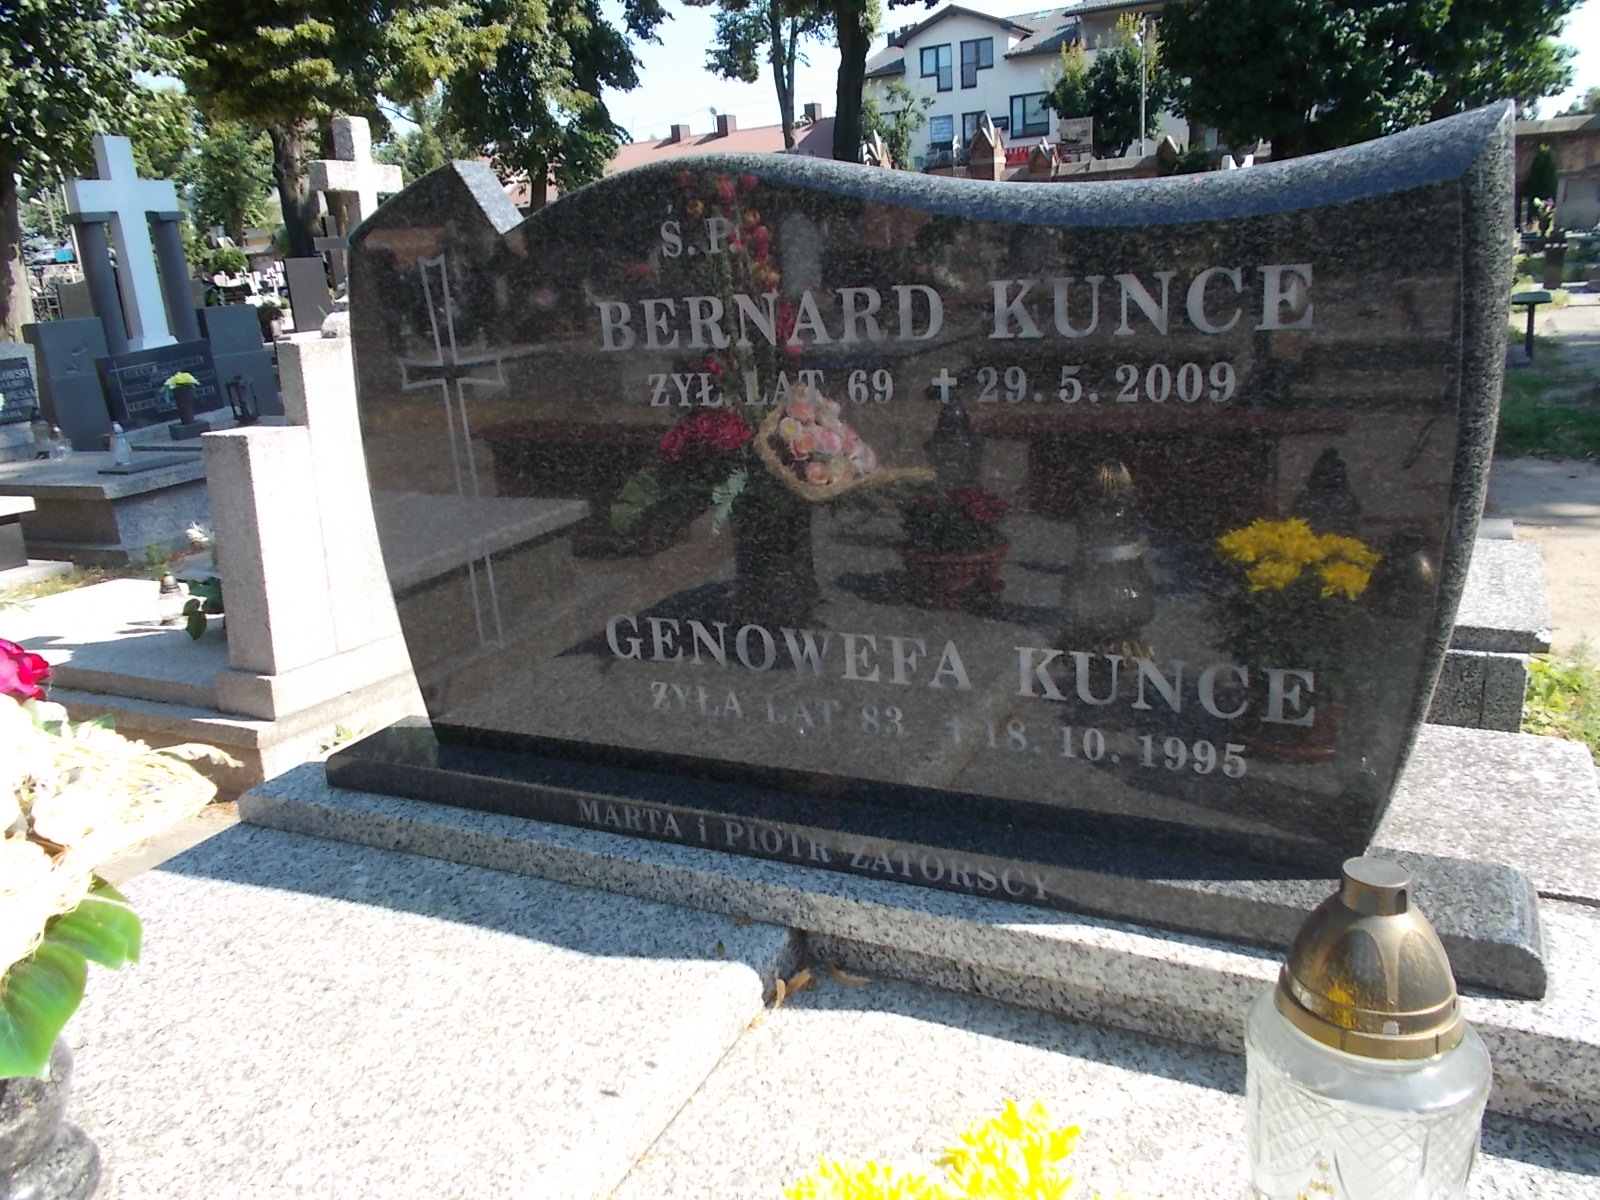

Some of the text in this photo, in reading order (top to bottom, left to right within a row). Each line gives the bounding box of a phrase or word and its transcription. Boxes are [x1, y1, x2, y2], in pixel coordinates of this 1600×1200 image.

[598, 263, 1313, 351] BERNARD KUNCE
[744, 369, 824, 406] LAT
[847, 369, 894, 404] 69
[605, 614, 1315, 727] GENOWEFA KUNCE
[766, 693, 840, 728] LAT
[862, 705, 904, 737] 83
[579, 800, 682, 837] MARTA
[725, 821, 831, 863] PIOTR
[850, 847, 1055, 900] ZATORSCY
